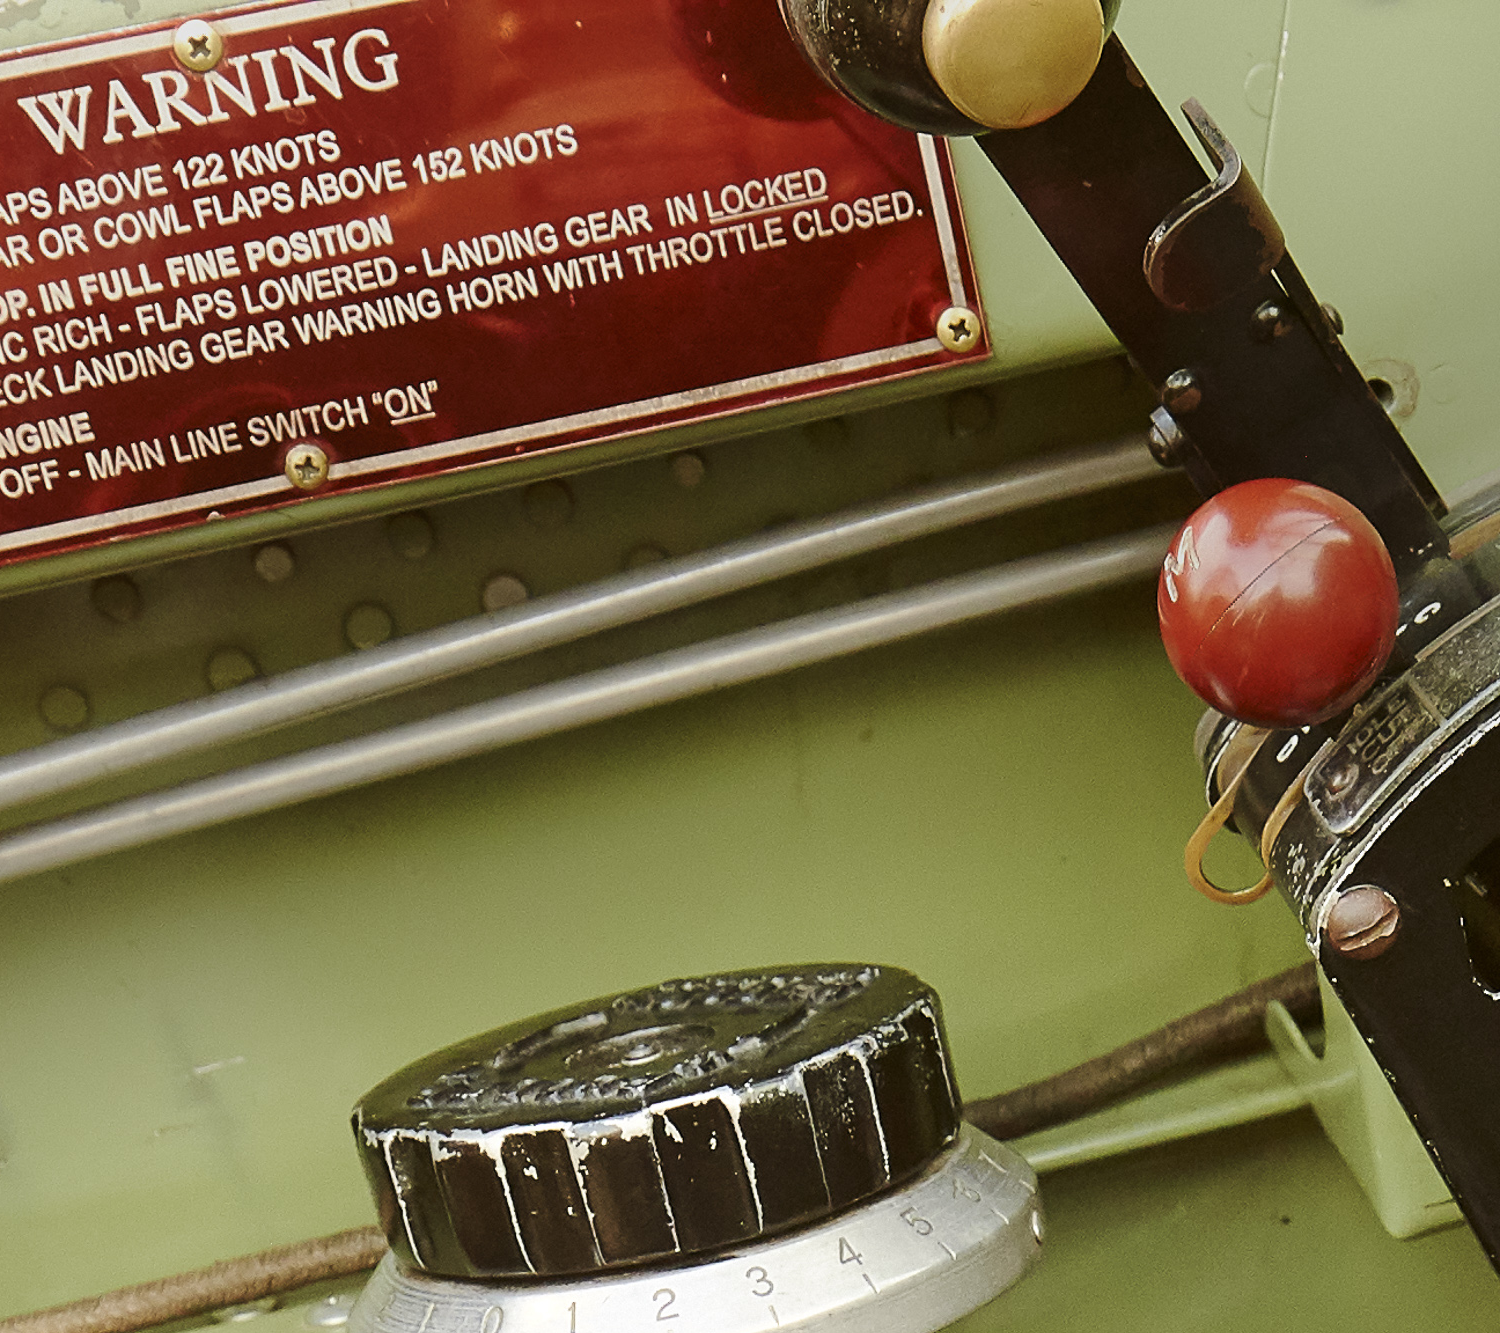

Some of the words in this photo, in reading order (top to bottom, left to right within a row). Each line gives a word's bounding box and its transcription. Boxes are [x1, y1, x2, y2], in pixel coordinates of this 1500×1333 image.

[18, 28, 402, 157] WARNING
[37, 222, 90, 260] OR
[92, 202, 193, 249] COWL
[191, 180, 296, 230] FLAPS
[299, 157, 408, 210] ABOVE
[411, 146, 467, 185] 152
[468, 123, 579, 174] KNOTS
[57, 162, 169, 216] ABOVE
[171, 152, 229, 191] 122
[229, 128, 342, 180] KNOTS
[31, 312, 114, 358] RICH
[134, 287, 238, 337] FLAPS
[239, 255, 399, 315] LOWERED
[420, 221, 560, 278] LANDING
[563, 203, 654, 248] GEAR
[664, 191, 699, 228] IN
[701, 166, 830, 225] LOCKED
[36, 278, 76, 315] IN
[77, 262, 165, 307] FULL
[164, 244, 242, 289] FINE
[242, 212, 394, 273] POSITION
[52, 338, 195, 395] LANDING
[199, 319, 291, 364] GEAR
[290, 287, 443, 346] WARNING
[445, 266, 540, 315] HORN
[541, 248, 625, 294] WITH
[624, 215, 788, 276] THROTTLE
[791, 189, 924, 242] CLOSED.
[84, 437, 167, 482] MAIN
[168, 421, 243, 464] LINE
[246, 395, 370, 447] SWITCH
[1163, 525, 1201, 603] M
[567, 1301, 577, 1333] 1
[651, 1287, 680, 1323] 2
[746, 1265, 776, 1299] 3
[837, 1235, 864, 1267] 4
[900, 1206, 935, 1236] 5
